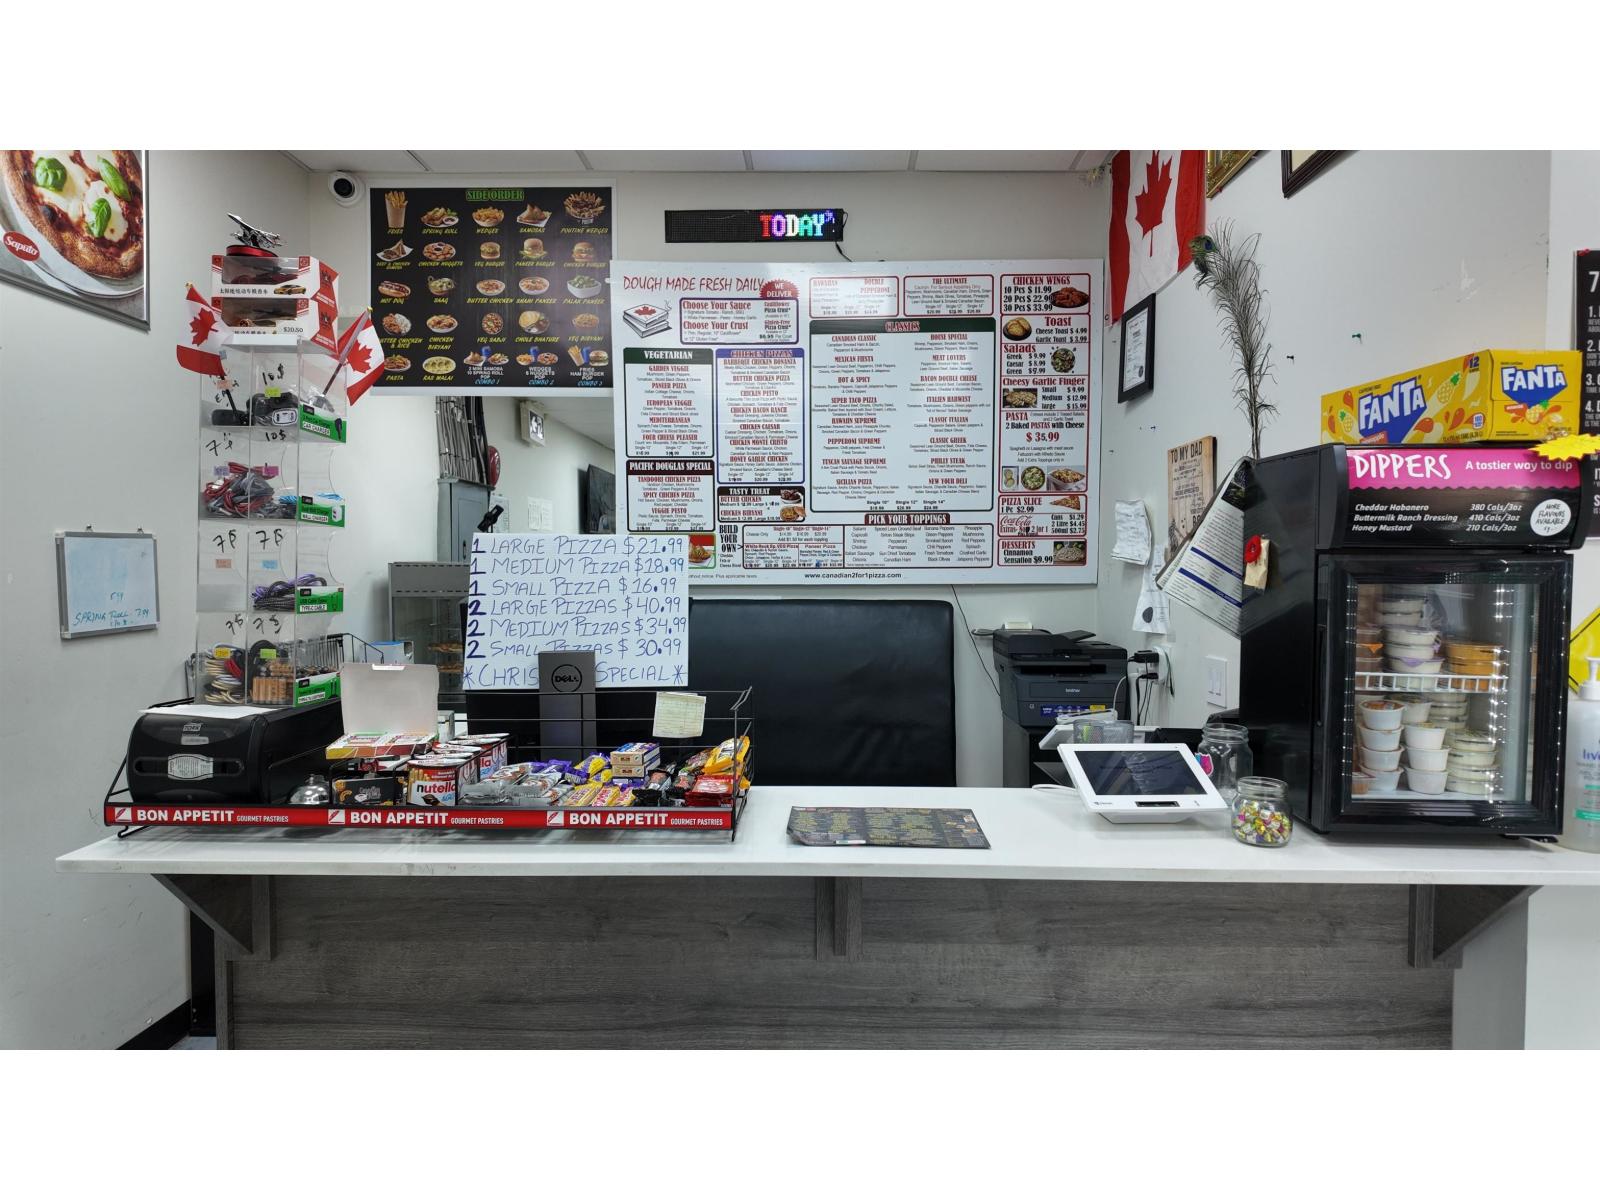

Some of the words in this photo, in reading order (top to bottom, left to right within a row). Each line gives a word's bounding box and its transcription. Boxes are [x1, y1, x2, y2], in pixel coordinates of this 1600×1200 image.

[467, 190, 488, 200] SIDE
[489, 190, 524, 200] ORDER
[5, 236, 38, 256] Saputo
[623, 276, 662, 291] DOUGH
[666, 276, 696, 291] MADE
[700, 277, 732, 292] FRESH
[736, 277, 765, 292] DAILY
[774, 282, 784, 290] WE
[1012, 276, 1044, 286] CHICKEN
[1046, 276, 1070, 284] WINGS
[766, 290, 792, 298] DELIVER
[1004, 286, 1012, 294] 10
[1014, 286, 1025, 294] Pcs
[1028, 286, 1032, 294] $
[1034, 286, 1052, 294] 11.99
[682, 302, 708, 310] Choose
[710, 302, 728, 310] Your
[730, 302, 752, 310] Sauce
[1004, 304, 1012, 312] 30
[1014, 304, 1025, 312] Pcs
[1026, 304, 1032, 312] $
[1033, 304, 1052, 312] 33.99
[683, 321, 709, 330] Choose
[710, 321, 730, 330] Your
[730, 321, 749, 330] Crust
[1044, 316, 1072, 326] Toast
[885, 322, 920, 332] CLASSICS
[1004, 344, 1036, 354] Salads
[644, 350, 693, 360] VEGETARIAN
[1469, 356, 1479, 368] 12
[1003, 378, 1029, 386] Cheesy
[1032, 378, 1057, 386] Garlic
[1059, 378, 1086, 387] Finger
[1502, 366, 1566, 391] FANTA
[1359, 380, 1426, 430] FANTA
[1006, 412, 1028, 420] PASTA
[1026, 432, 1032, 442] $
[1170, 449, 1178, 464] TO
[1180, 445, 1188, 460] MY
[1190, 441, 1202, 458] DAD
[630, 462, 654, 470] PACIFIC
[656, 462, 685, 470] DOUGLAS
[686, 462, 712, 470] SPECIAL
[1354, 454, 1452, 480] DIPPERS
[1466, 460, 1474, 470] A
[1476, 460, 1513, 470] tastier
[1514, 462, 1538, 473] way
[1540, 461, 1552, 470] to
[1554, 460, 1573, 473] dip
[1002, 498, 1021, 506] PIZZA
[1024, 498, 1042, 506] SLICE
[1355, 504, 1388, 512] Cheddar
[1390, 504, 1429, 512] Habanero
[1486, 503, 1522, 513] Cals/3oz
[868, 514, 886, 524] PICK
[888, 514, 908, 524] YOUR
[910, 514, 947, 524] TOPPINGS
[1354, 514, 1396, 522] Buttermilk
[1398, 514, 1422, 522] Ranch
[1424, 514, 1458, 524] Dressing
[1468, 514, 1484, 522] 410
[1484, 513, 1520, 523] Cals/3oz
[719, 525, 738, 534] BUILD
[1352, 524, 1378, 534] Honey
[1378, 524, 1412, 532] Mustard
[1466, 524, 1480, 532] 210
[1482, 523, 1517, 533] Cals/3oz
[720, 534, 738, 543] YOUR
[472, 538, 486, 554] 1
[490, 538, 546, 554] LARGE
[554, 536, 617, 556] PIZZA
[622, 536, 684, 557] $21.99
[722, 544, 736, 552] OWN
[1002, 541, 1036, 550] DESSERTS
[470, 558, 486, 576] 1
[491, 557, 574, 576] MEDIUM
[578, 557, 630, 576] PIZZA
[634, 556, 684, 577] $18.99
[804, 572, 902, 580] www.canadian2for1pizza.com
[469, 580, 486, 596] 1
[492, 579, 546, 596] SMALL
[550, 576, 610, 597] PIZZA
[468, 600, 486, 616] 2
[490, 600, 548, 616] LARGE
[552, 596, 617, 616] PIZZAS
[467, 620, 486, 638] 2
[490, 618, 569, 639] MEDIUM
[570, 616, 631, 636] PIZZAS
[466, 640, 486, 658] 2
[490, 641, 539, 656] SMALL
[554, 674, 580, 683] DELL
[416, 781, 456, 794] nutella
[137, 810, 168, 822] BON
[172, 810, 234, 822] APPETIT
[350, 812, 382, 824] BON
[386, 812, 448, 824] APPETIT
[569, 812, 601, 824] BON
[605, 813, 668, 825] APPETIT
[670, 818, 696, 826] GOURMET
[697, 818, 723, 826] PASTRIES
